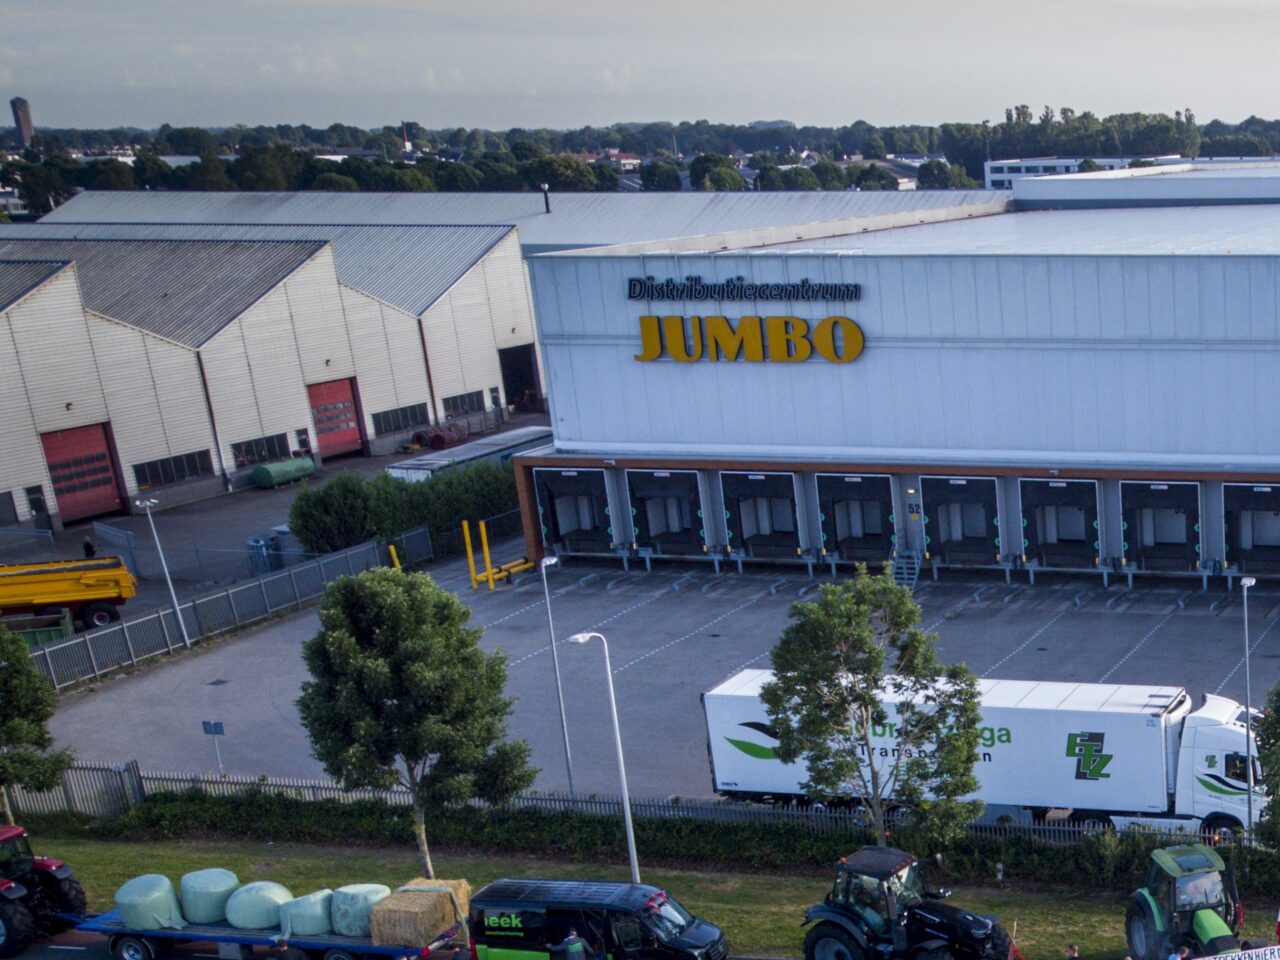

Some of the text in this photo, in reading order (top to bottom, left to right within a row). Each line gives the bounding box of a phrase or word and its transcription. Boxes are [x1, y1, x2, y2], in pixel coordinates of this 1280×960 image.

[628, 276, 861, 301] Distributiecentrum
[634, 315, 865, 363] JUMBO
[908, 503, 921, 514] 52
